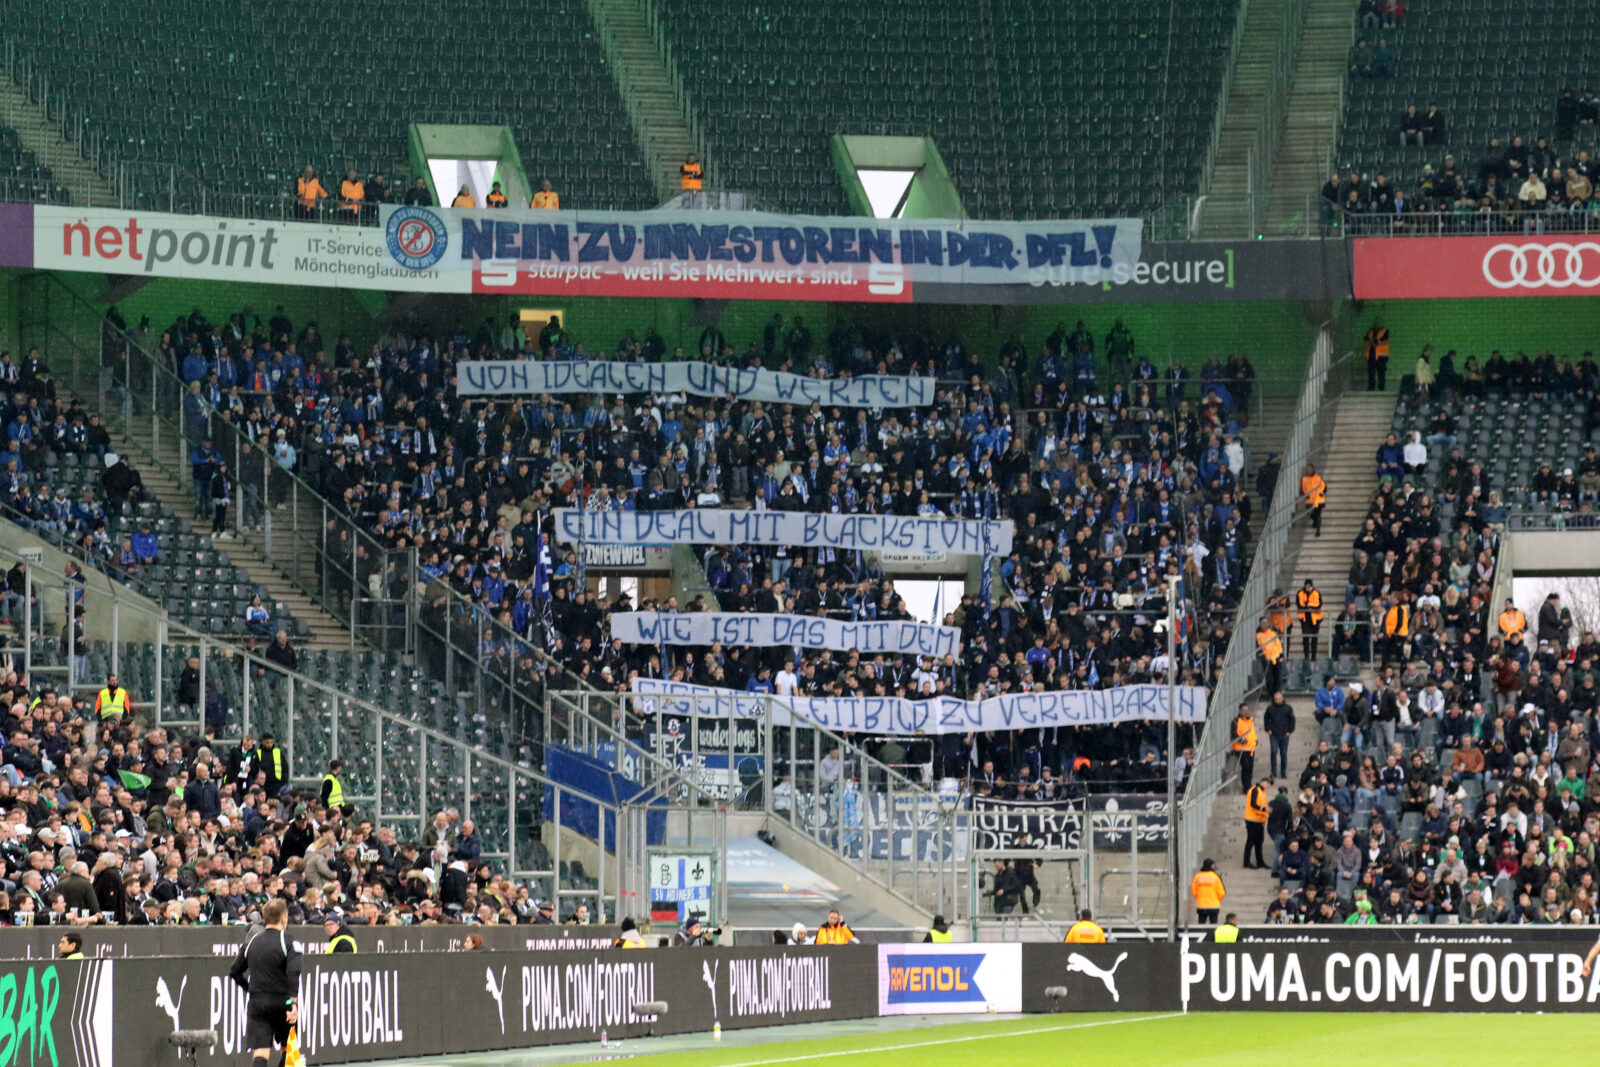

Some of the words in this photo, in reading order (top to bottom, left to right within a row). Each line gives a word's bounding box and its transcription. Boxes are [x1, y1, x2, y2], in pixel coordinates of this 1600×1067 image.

[63, 217, 278, 271] netpoint
[307, 238, 384, 257] IT-Service
[461, 218, 569, 261] NEIN
[575, 221, 637, 263] ZU
[643, 222, 893, 266] INVESTOREN
[898, 229, 943, 266] IN
[948, 231, 1019, 271] DER
[1025, 225, 1117, 269] DFL!
[623, 264, 664, 281] weil
[669, 265, 702, 282] Sie
[706, 264, 805, 285] Mehrwert
[810, 266, 858, 286] sind.
[466, 365, 528, 391] VON
[542, 362, 667, 392] IDEALEN
[687, 363, 758, 397] UND
[775, 375, 924, 406] WERTEN
[562, 509, 623, 541] EIN
[633, 509, 716, 541] DEAL
[730, 512, 785, 542] MIT
[804, 514, 1000, 552] BLACKSTONE
[637, 616, 691, 643] WIE
[711, 616, 759, 644] IST
[773, 618, 825, 646] DAS
[842, 623, 889, 651] MIT
[898, 623, 955, 655] DEM
[940, 699, 983, 727] ZU
[1001, 685, 1195, 726] VEREINBAREN
[522, 958, 658, 1032] PUMA.COM/FOOTBALL
[729, 953, 831, 1017] PUMA.COM/FOOTBALL
